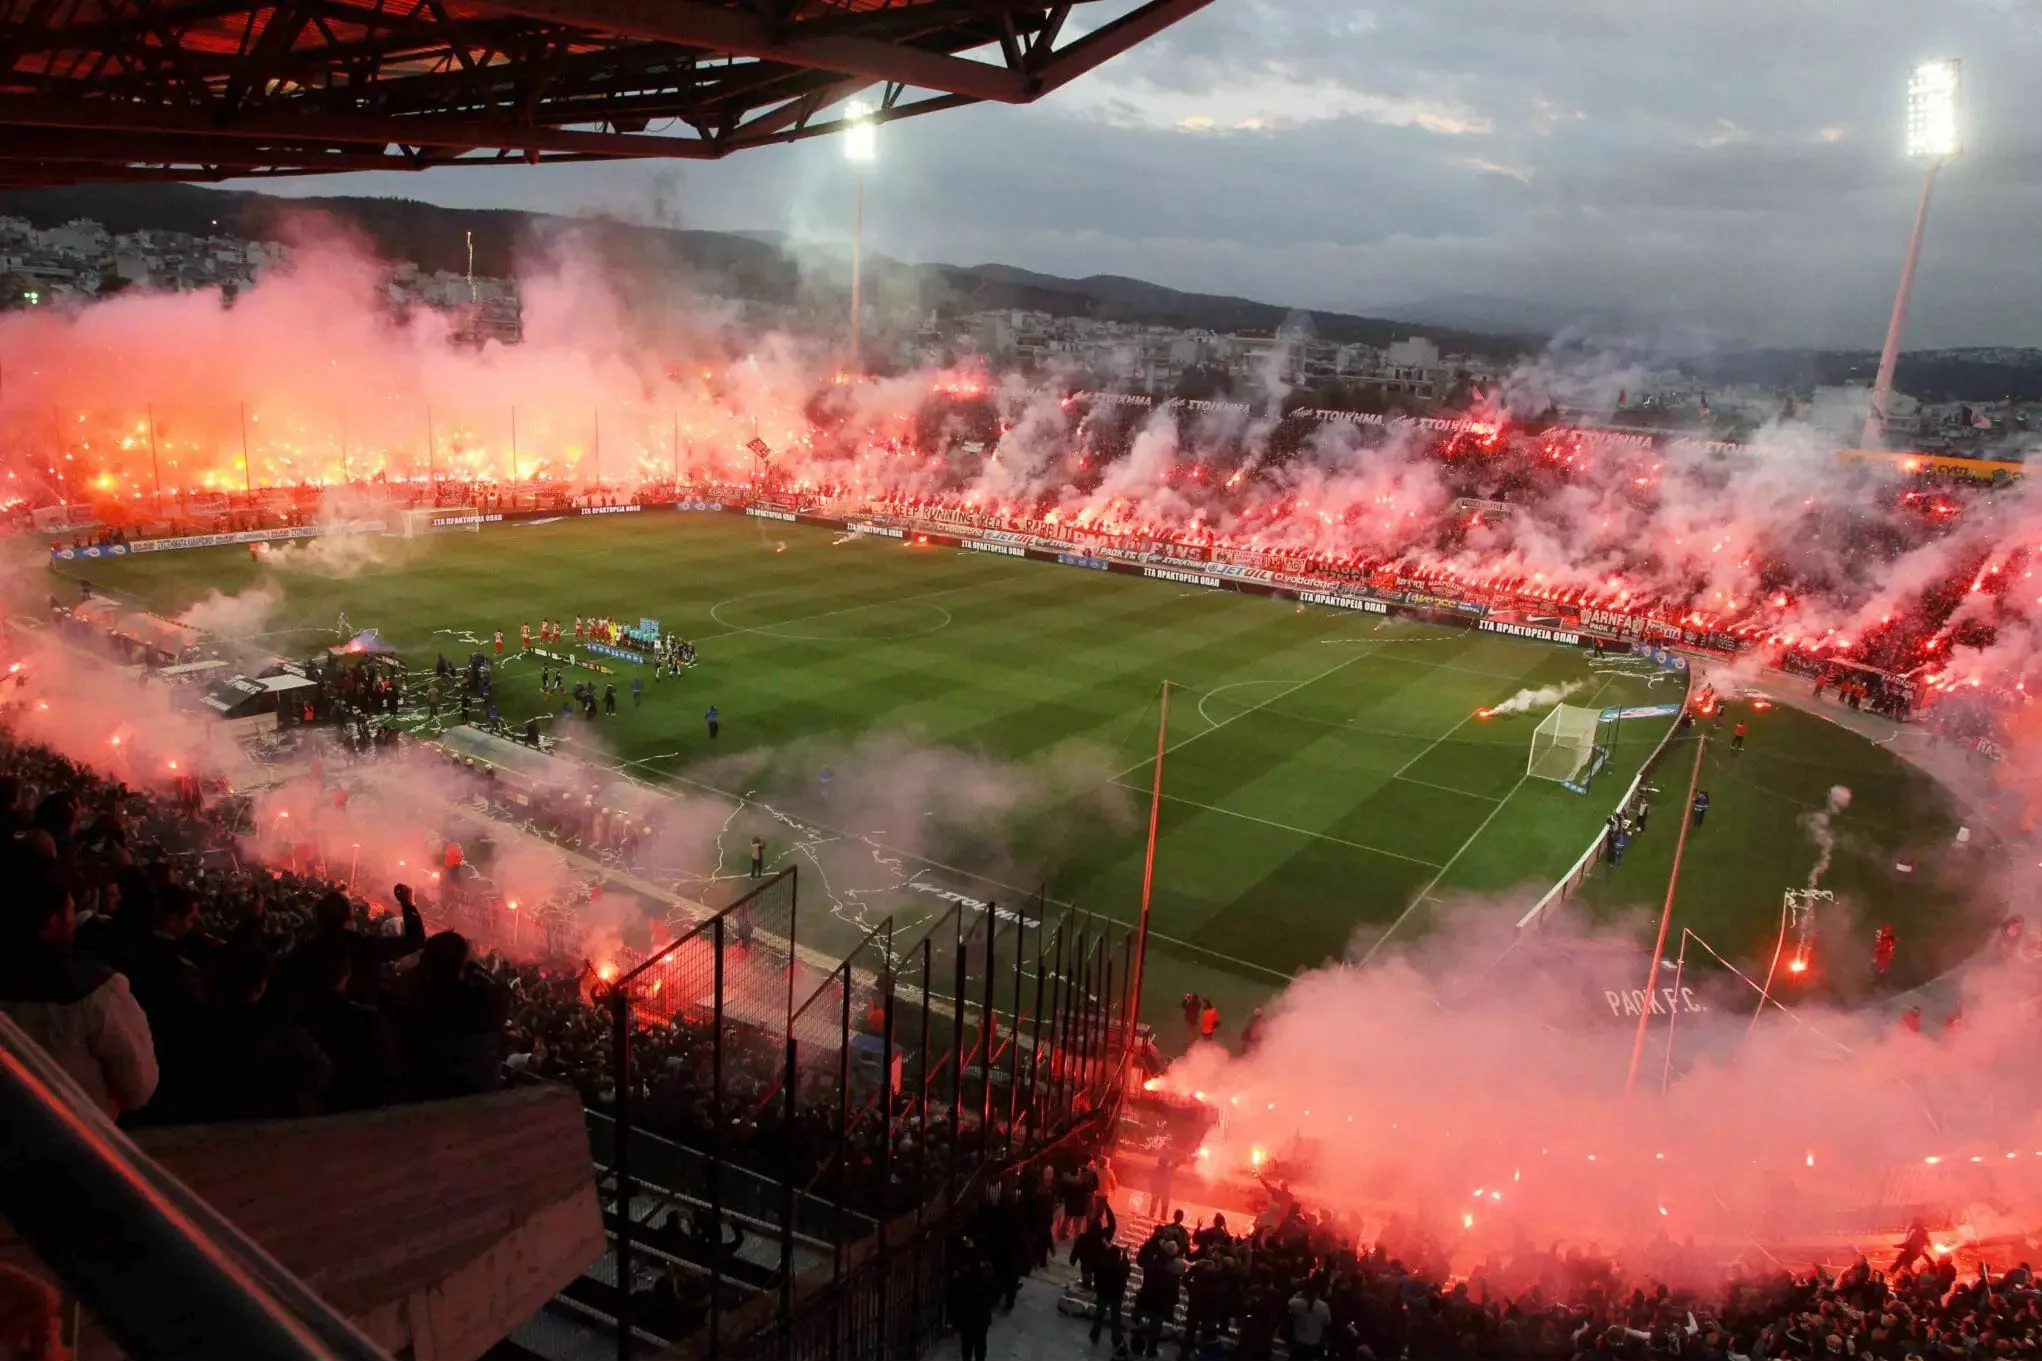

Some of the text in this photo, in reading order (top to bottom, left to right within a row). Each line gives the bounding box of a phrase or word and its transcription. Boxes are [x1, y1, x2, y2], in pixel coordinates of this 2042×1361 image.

[1300, 591, 1314, 602] ΣΤΑ
[1478, 619, 1580, 645] ΣΤΑ ΠΡΑΚΤΟΡΕΙΑ ΟΠΑΠ
